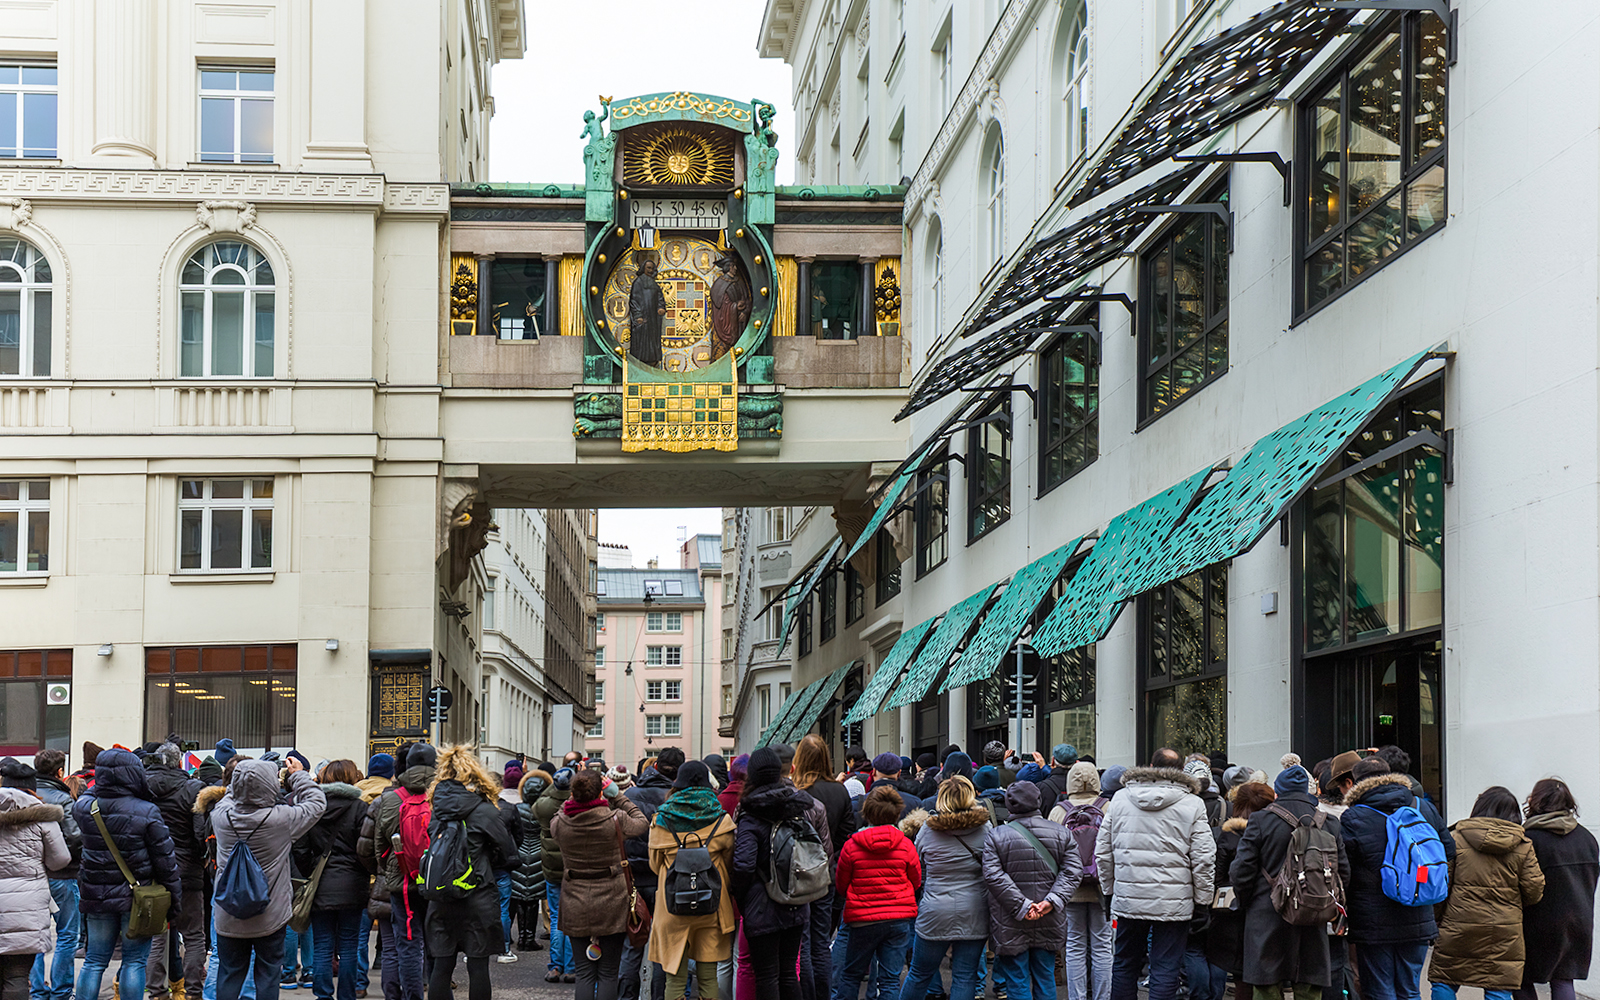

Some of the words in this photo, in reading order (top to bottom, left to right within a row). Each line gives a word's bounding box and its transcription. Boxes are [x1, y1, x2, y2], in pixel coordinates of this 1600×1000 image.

[632, 200, 640, 214] 0
[651, 200, 662, 215] 15
[670, 201, 685, 216] 30
[691, 201, 705, 216] 45
[711, 201, 726, 216] 60
